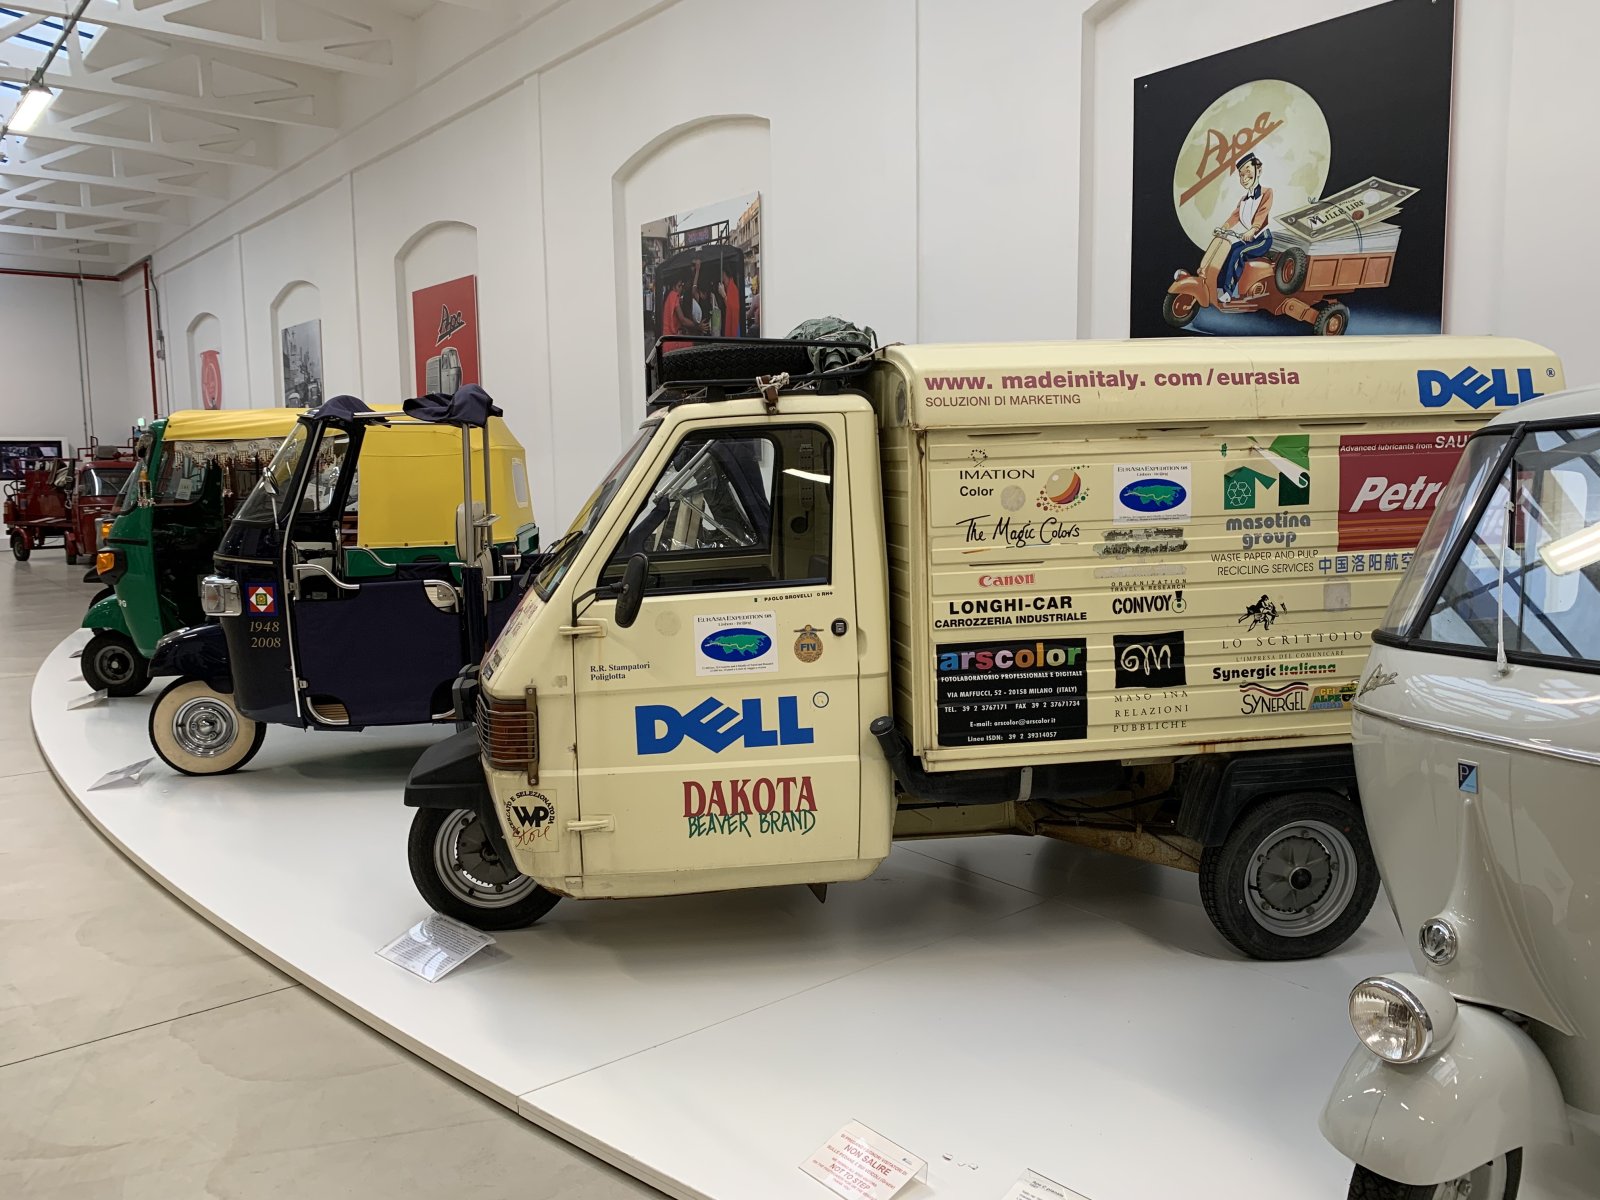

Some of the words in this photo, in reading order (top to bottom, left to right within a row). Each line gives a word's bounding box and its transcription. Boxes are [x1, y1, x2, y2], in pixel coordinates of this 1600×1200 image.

[1185, 111, 1283, 197] Ape
[435, 304, 467, 346] Ape
[924, 376, 993, 390] www.
[1002, 370, 1146, 390] madeinitaly.
[1417, 365, 1545, 410] DELL
[925, 396, 991, 407] SOLUZIONI
[994, 395, 1006, 406] DI
[1010, 394, 1081, 405] MARKETING
[1378, 443, 1414, 451] lubricants
[1435, 435, 1470, 449] SAU
[960, 469, 1035, 480] IMATION
[960, 486, 994, 497] Color
[1226, 511, 1311, 531] masotina
[956, 514, 991, 542] The
[992, 517, 1035, 548] Magic
[1040, 517, 1080, 544] Colors
[1242, 531, 1297, 550] group
[1211, 552, 1241, 562] WASTE
[1244, 551, 1271, 561] PAPER
[1275, 550, 1295, 559] AND
[1297, 549, 1319, 559] PULP
[1217, 564, 1269, 576] RECICLING
[1272, 562, 1314, 574] SERVICES
[979, 573, 1035, 587] Canon
[1111, 579, 1187, 587] ORGANIZATION
[949, 596, 1072, 615] LONGHI-CAR
[250, 621, 280, 633] 1948
[935, 616, 1012, 629] CARROZZERIA
[1016, 612, 1087, 624] INDUSTRIALE
[251, 637, 281, 648] 2008
[800, 643, 817, 652] FIV
[1222, 638, 1242, 649] LO
[1257, 631, 1363, 646] SCRITTOIO
[939, 642, 1081, 671] arscolor
[1236, 655, 1276, 663] L'IMPRESA
[1279, 652, 1292, 660] DEL
[1296, 650, 1344, 659] COMUNICARE
[590, 664, 607, 673] R.R.
[608, 661, 650, 672] Stampatori
[1213, 665, 1276, 681] Synergic
[1279, 662, 1336, 676] Italiana
[590, 673, 626, 682] Poliglotta
[940, 674, 999, 683] FOTOLABORATORIO
[1001, 672, 1048, 680] PROFESSIONALE
[1055, 670, 1083, 678] DIGITALE
[960, 690, 993, 698] MAFFUCCI,
[1029, 687, 1053, 695] MILANO
[1050, 700, 1080, 708] 37671734
[1115, 704, 1188, 717] RELAZIONI
[1241, 691, 1306, 715] SYNERGEL
[635, 696, 815, 756] DELL
[1113, 720, 1187, 732] PUBBLICHE
[515, 791, 555, 815] SELEZIONATO
[682, 776, 818, 818] DAKOTA
[511, 806, 550, 827] WP
[688, 811, 752, 839] BEAVER
[759, 809, 816, 836] BRAND
[844, 1144, 863, 1158] NON
[861, 1155, 892, 1176] SALIRE
[830, 1163, 845, 1174] NOT
[844, 1171, 854, 1180] TO
[852, 1176, 871, 1191] STEP
